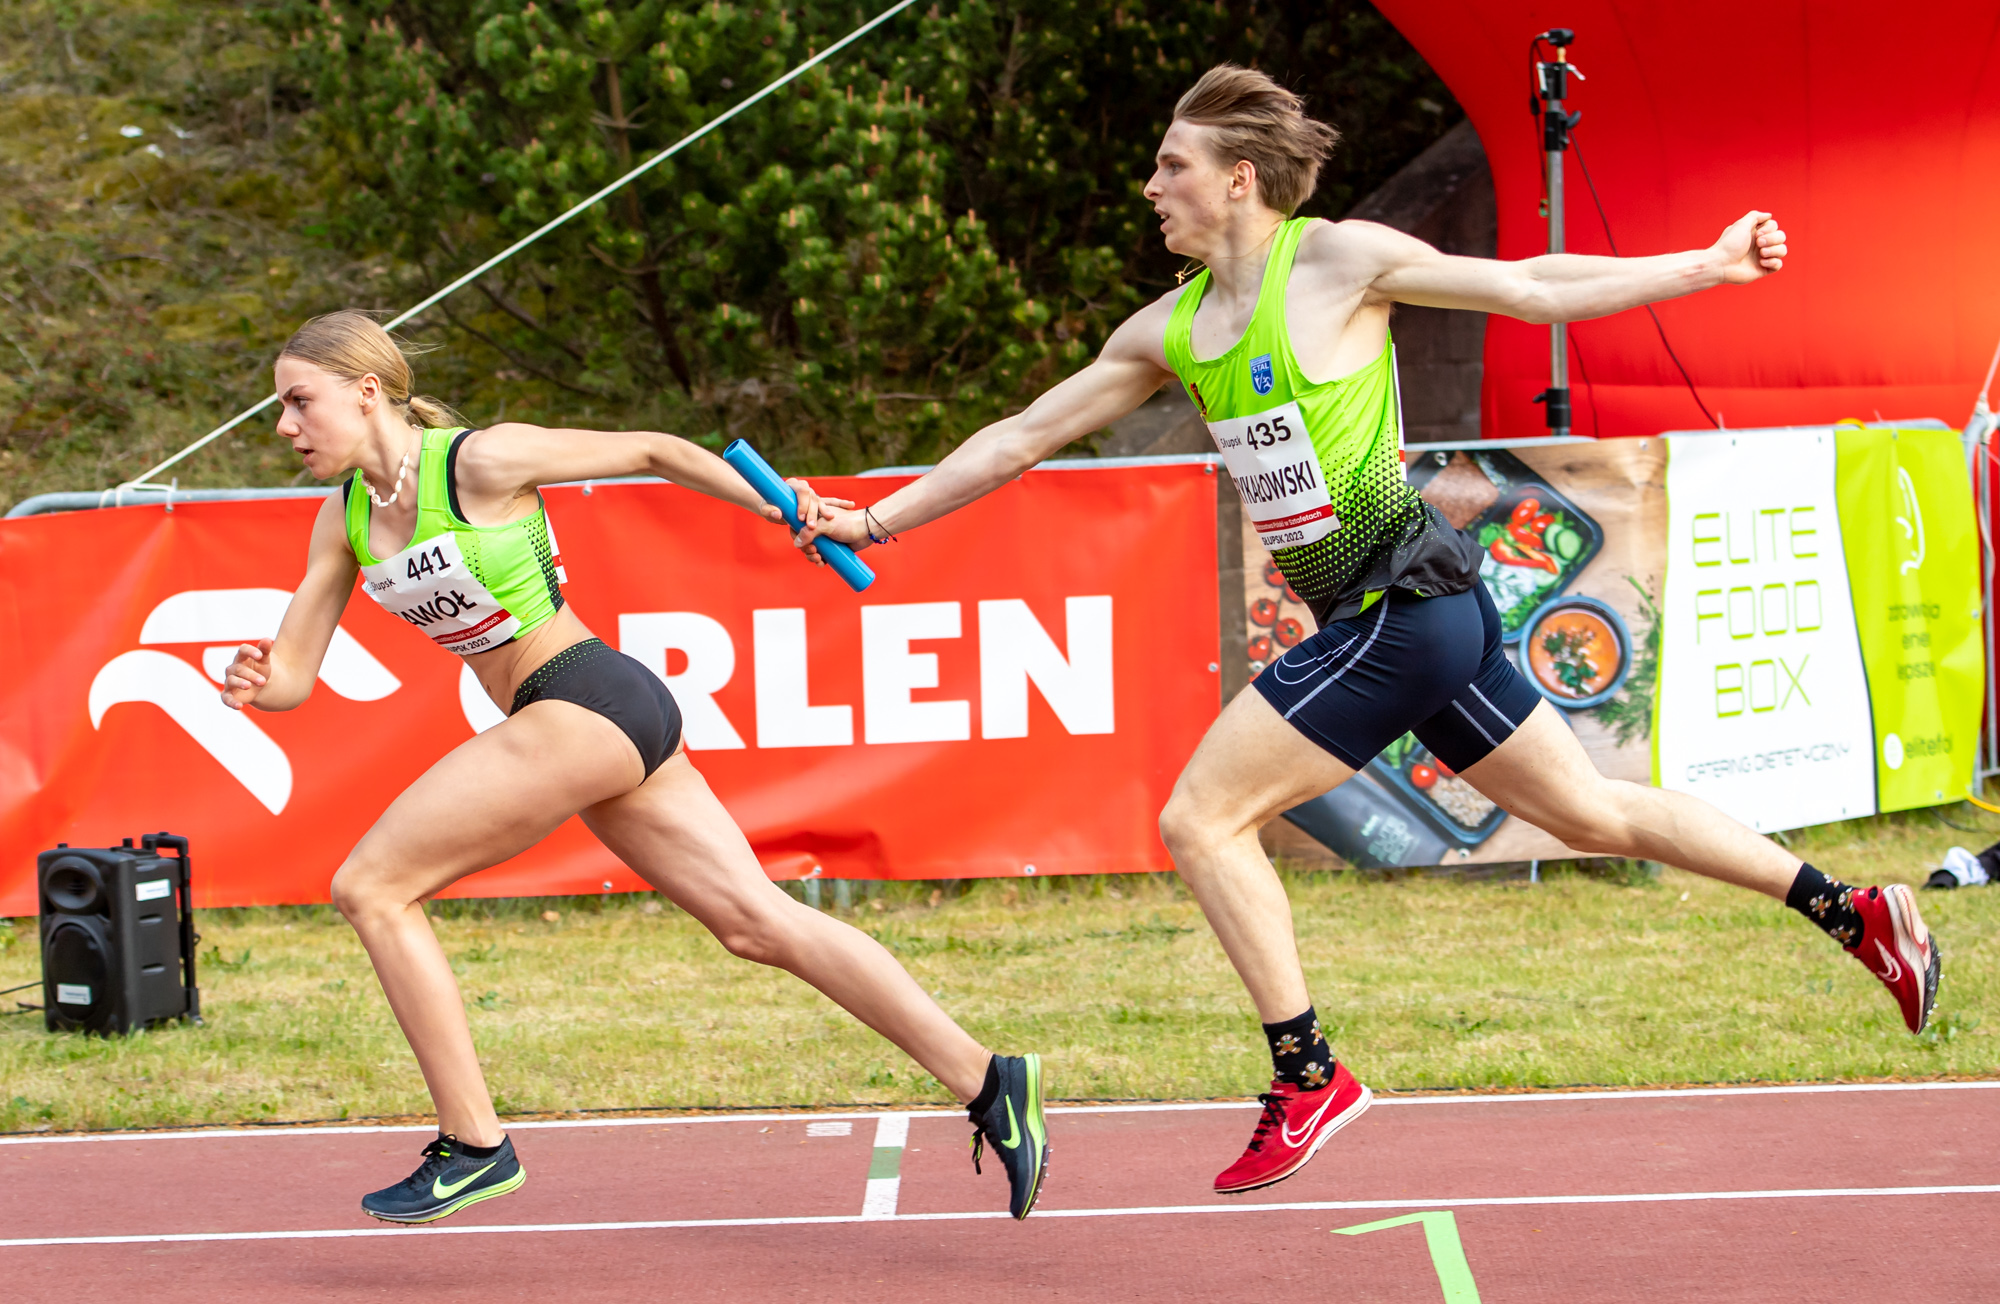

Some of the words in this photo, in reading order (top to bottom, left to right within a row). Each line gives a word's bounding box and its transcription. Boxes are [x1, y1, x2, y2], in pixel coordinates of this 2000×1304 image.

[1252, 362, 1270, 374] STAL
[1246, 415, 1292, 451] 435
[1288, 510, 1323, 525] Sztafetach
[1261, 534, 1286, 546] SŁUPSK
[1284, 530, 1304, 542] 2023
[1692, 505, 1819, 568] ELITE
[406, 545, 451, 582] 441
[391, 589, 478, 627] AWÓŁ
[470, 616, 501, 636] Sztafetach
[1695, 579, 1822, 645] FOOD
[467, 636, 491, 650] 2023
[1715, 653, 1812, 719] BOX
[1687, 757, 1751, 782] CATERING
[1755, 741, 1851, 772] DIETETYCZNY
